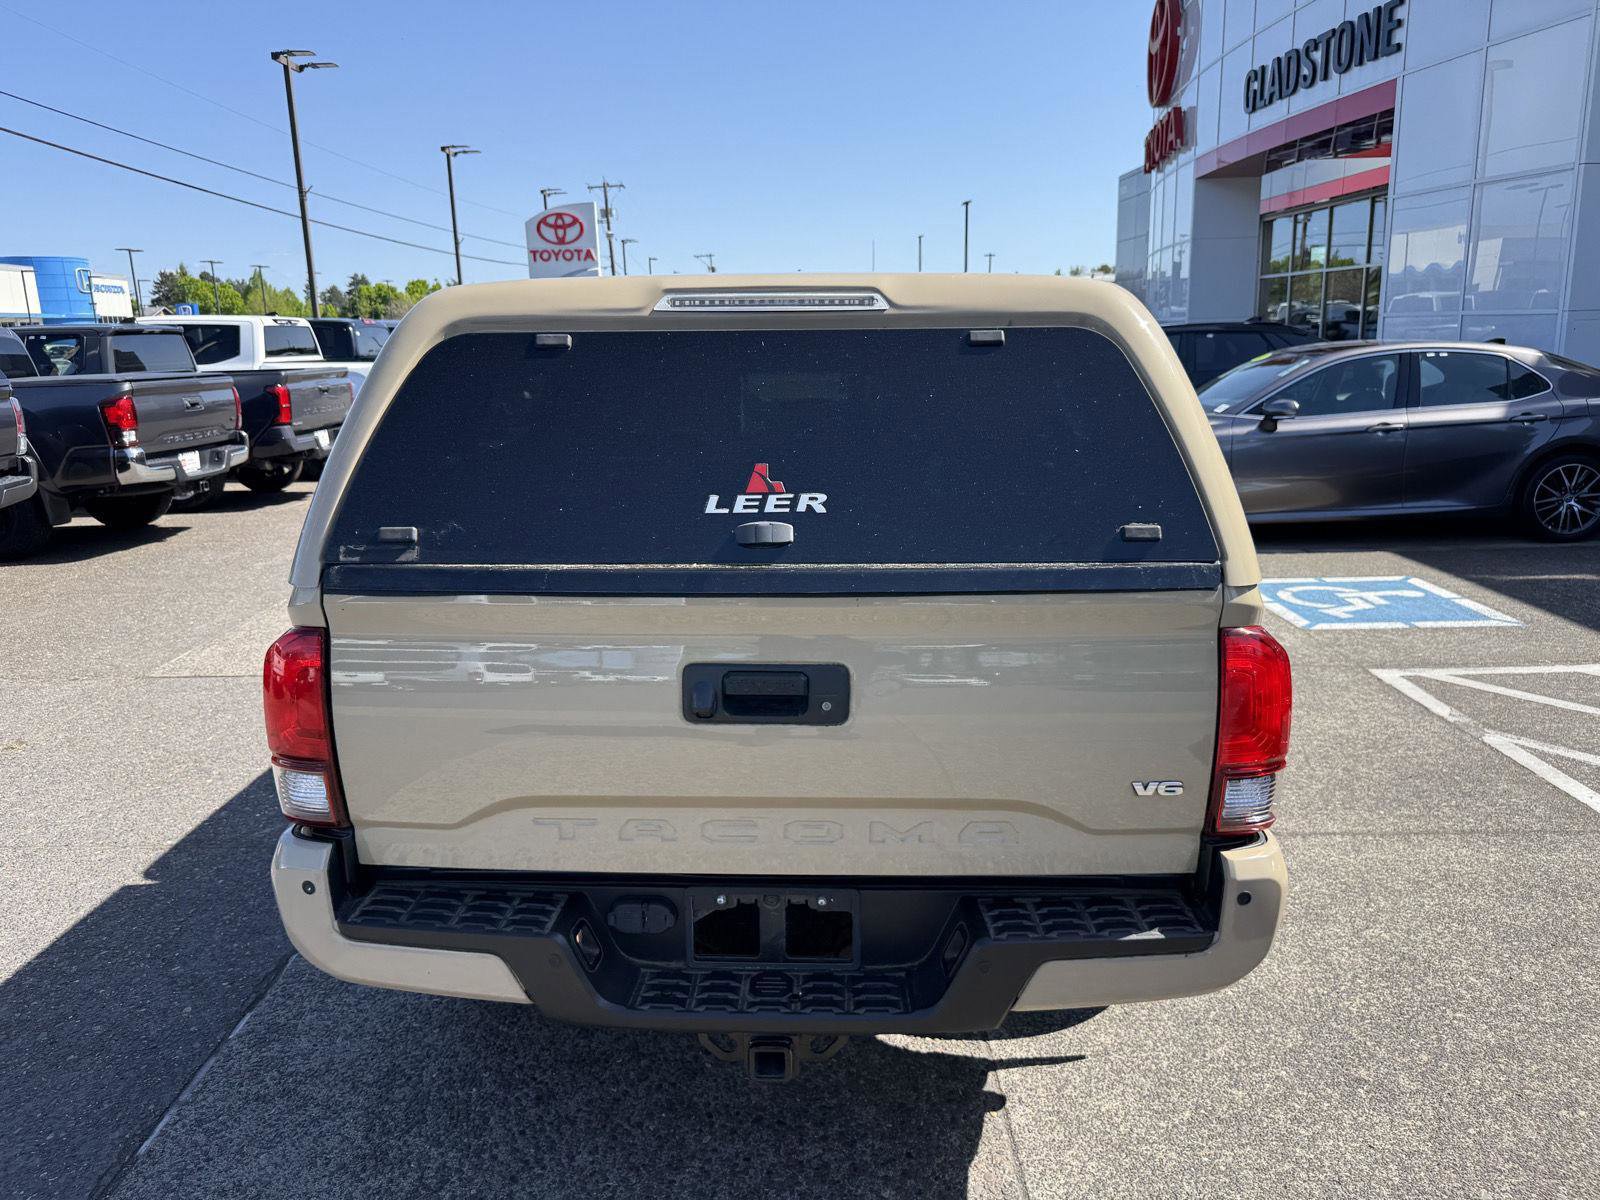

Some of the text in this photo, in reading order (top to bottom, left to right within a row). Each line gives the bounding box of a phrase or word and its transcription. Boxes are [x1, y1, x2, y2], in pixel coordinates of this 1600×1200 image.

[1244, 0, 1404, 114] GLADSTONE
[529, 248, 596, 262] TOYOTA
[704, 492, 828, 514] LEER
[1131, 780, 1184, 796] V6
[533, 816, 1020, 846] TACOMA
